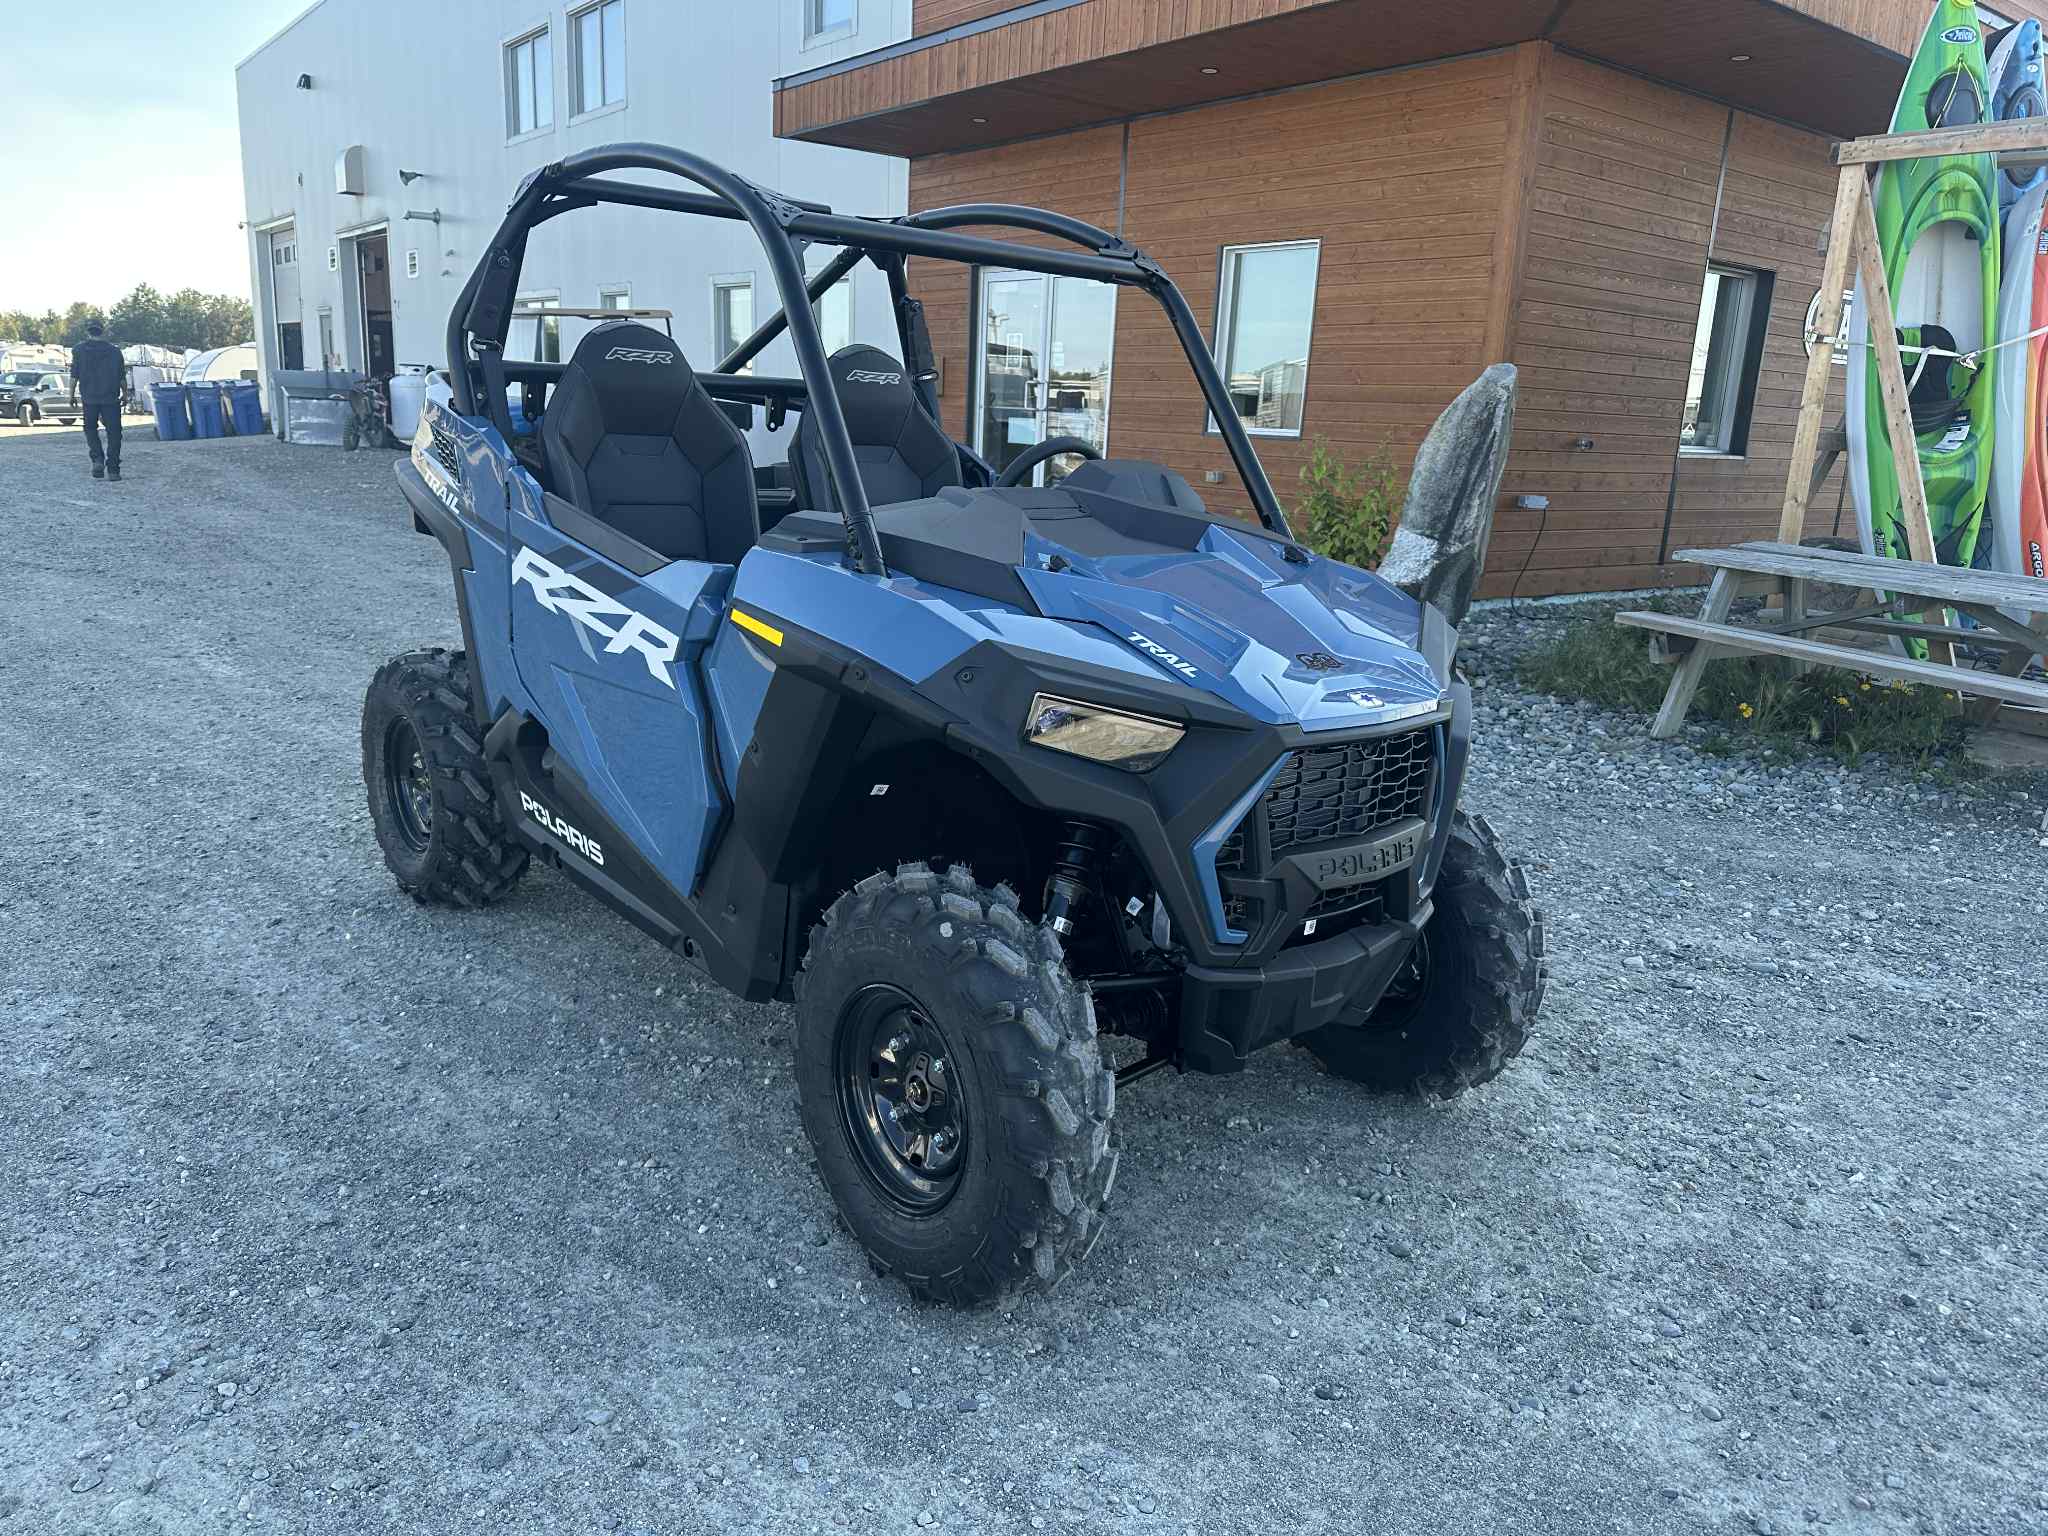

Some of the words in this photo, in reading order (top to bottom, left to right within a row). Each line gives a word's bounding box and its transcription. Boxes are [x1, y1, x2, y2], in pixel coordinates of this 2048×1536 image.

[604, 346, 674, 364] RZR
[846, 369, 901, 385] RZR
[424, 468, 460, 515] TRAIL
[2031, 541, 2044, 578] ARGO
[511, 545, 680, 690] RZR
[1127, 631, 1201, 678] TRAIL
[520, 790, 604, 866] POLARIS
[1319, 836, 1414, 881] POLARIS
